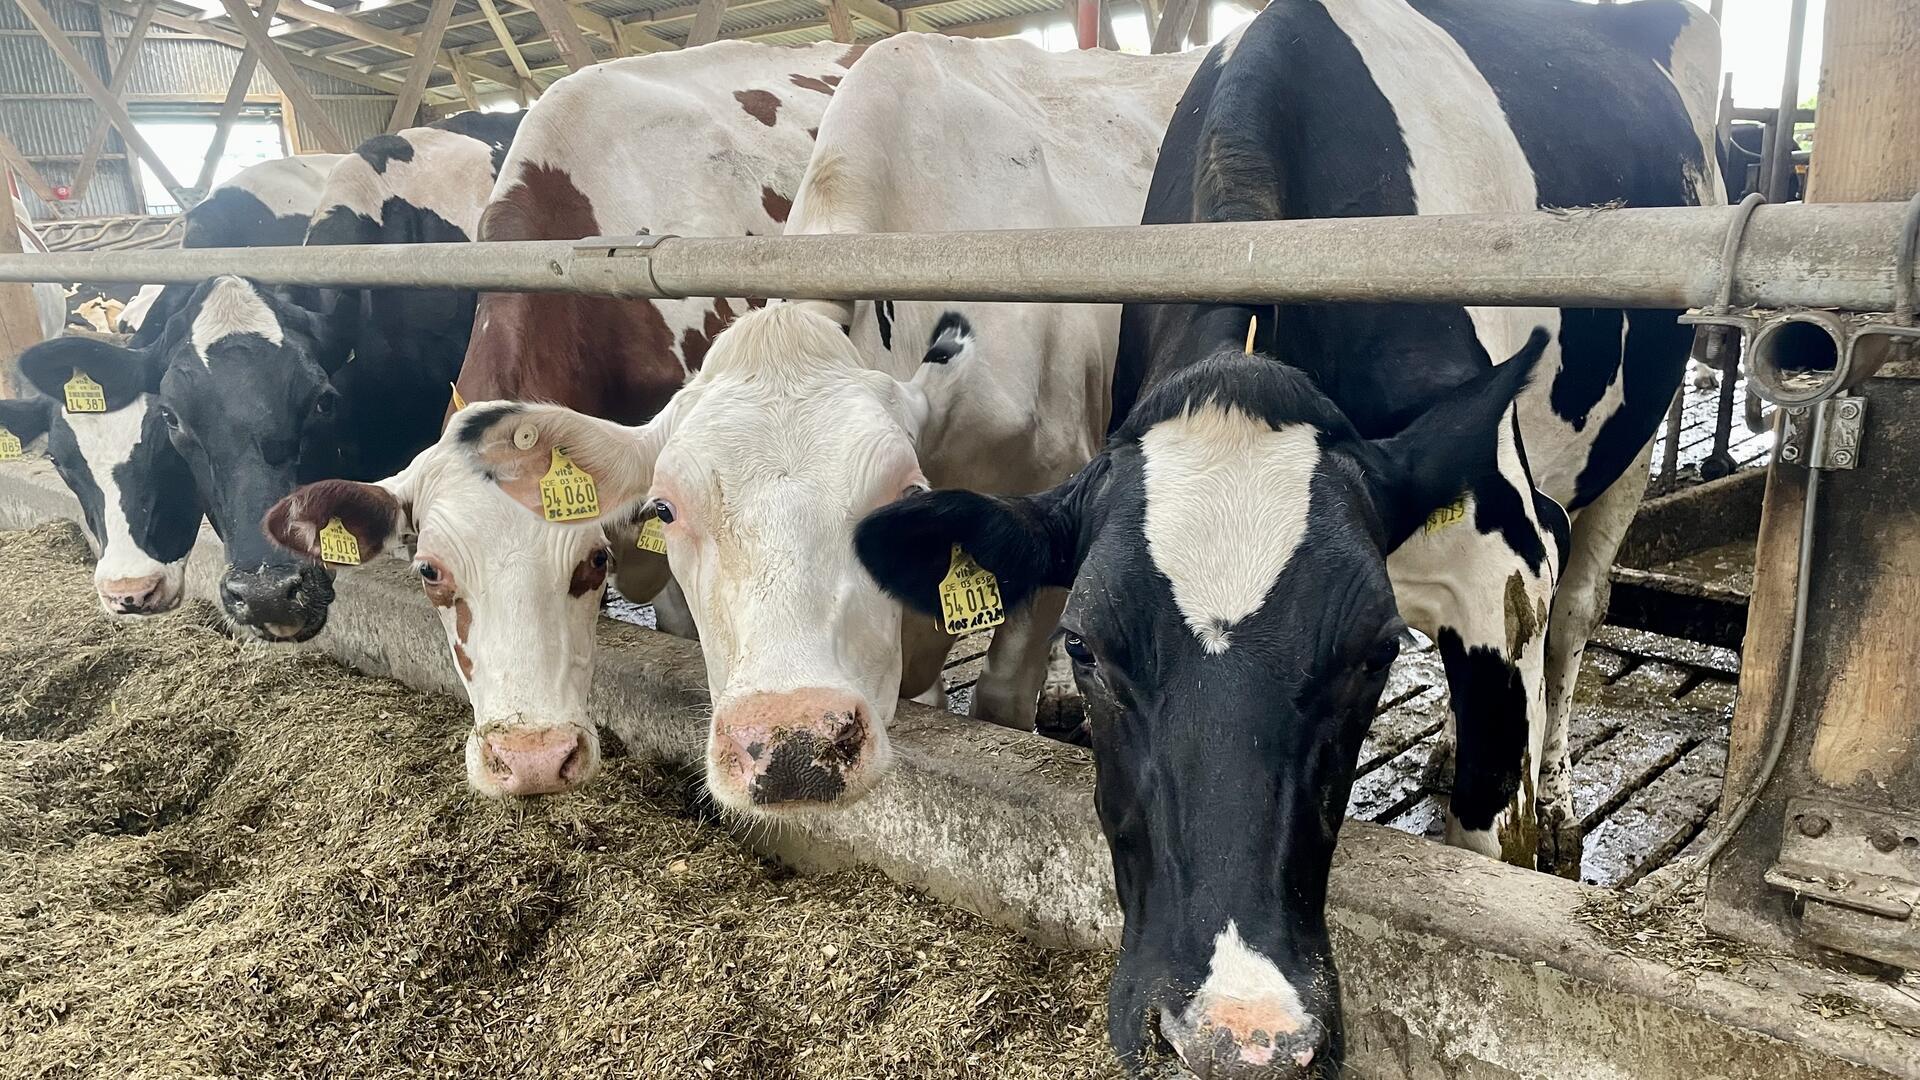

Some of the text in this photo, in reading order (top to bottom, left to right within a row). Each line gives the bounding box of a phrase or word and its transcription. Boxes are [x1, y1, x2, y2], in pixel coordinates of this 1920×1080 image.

[85, 399, 104, 411] 387
[543, 483, 595, 508] 54 060
[336, 539, 358, 555] 018
[945, 583, 957, 592] DE
[960, 580, 972, 589] 03
[943, 583, 1000, 618] 54 013
